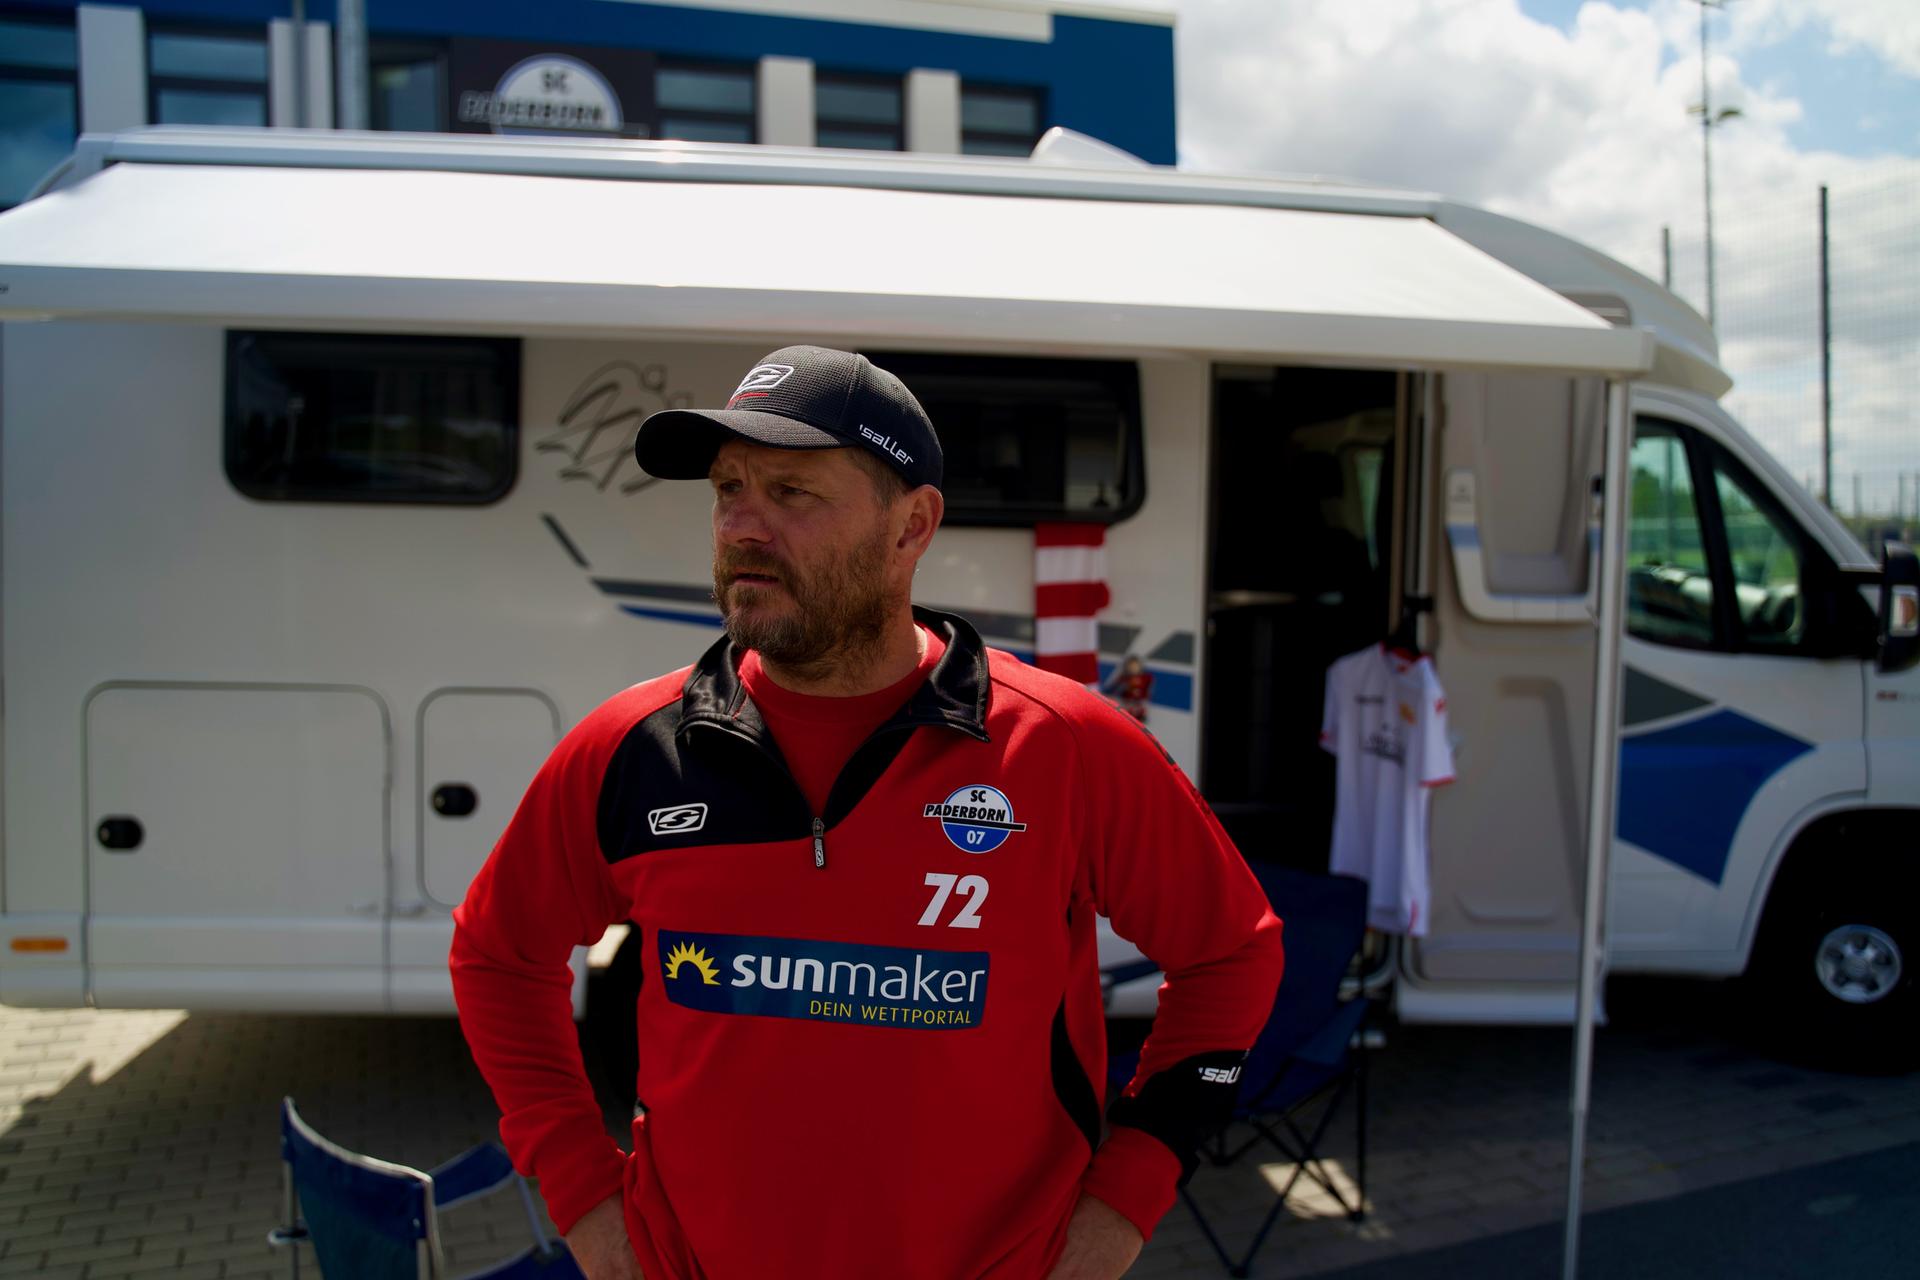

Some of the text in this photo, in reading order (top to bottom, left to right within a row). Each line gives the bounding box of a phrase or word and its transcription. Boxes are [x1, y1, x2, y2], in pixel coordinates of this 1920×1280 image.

[541, 69, 570, 92] SC
[970, 790, 987, 803] SC
[924, 804, 1007, 822] PADERBORN
[966, 830, 985, 845] 07
[917, 872, 990, 929] 72
[730, 953, 986, 1004] sunmaker
[809, 1000, 973, 1025] DEIN WETTPORTAL
